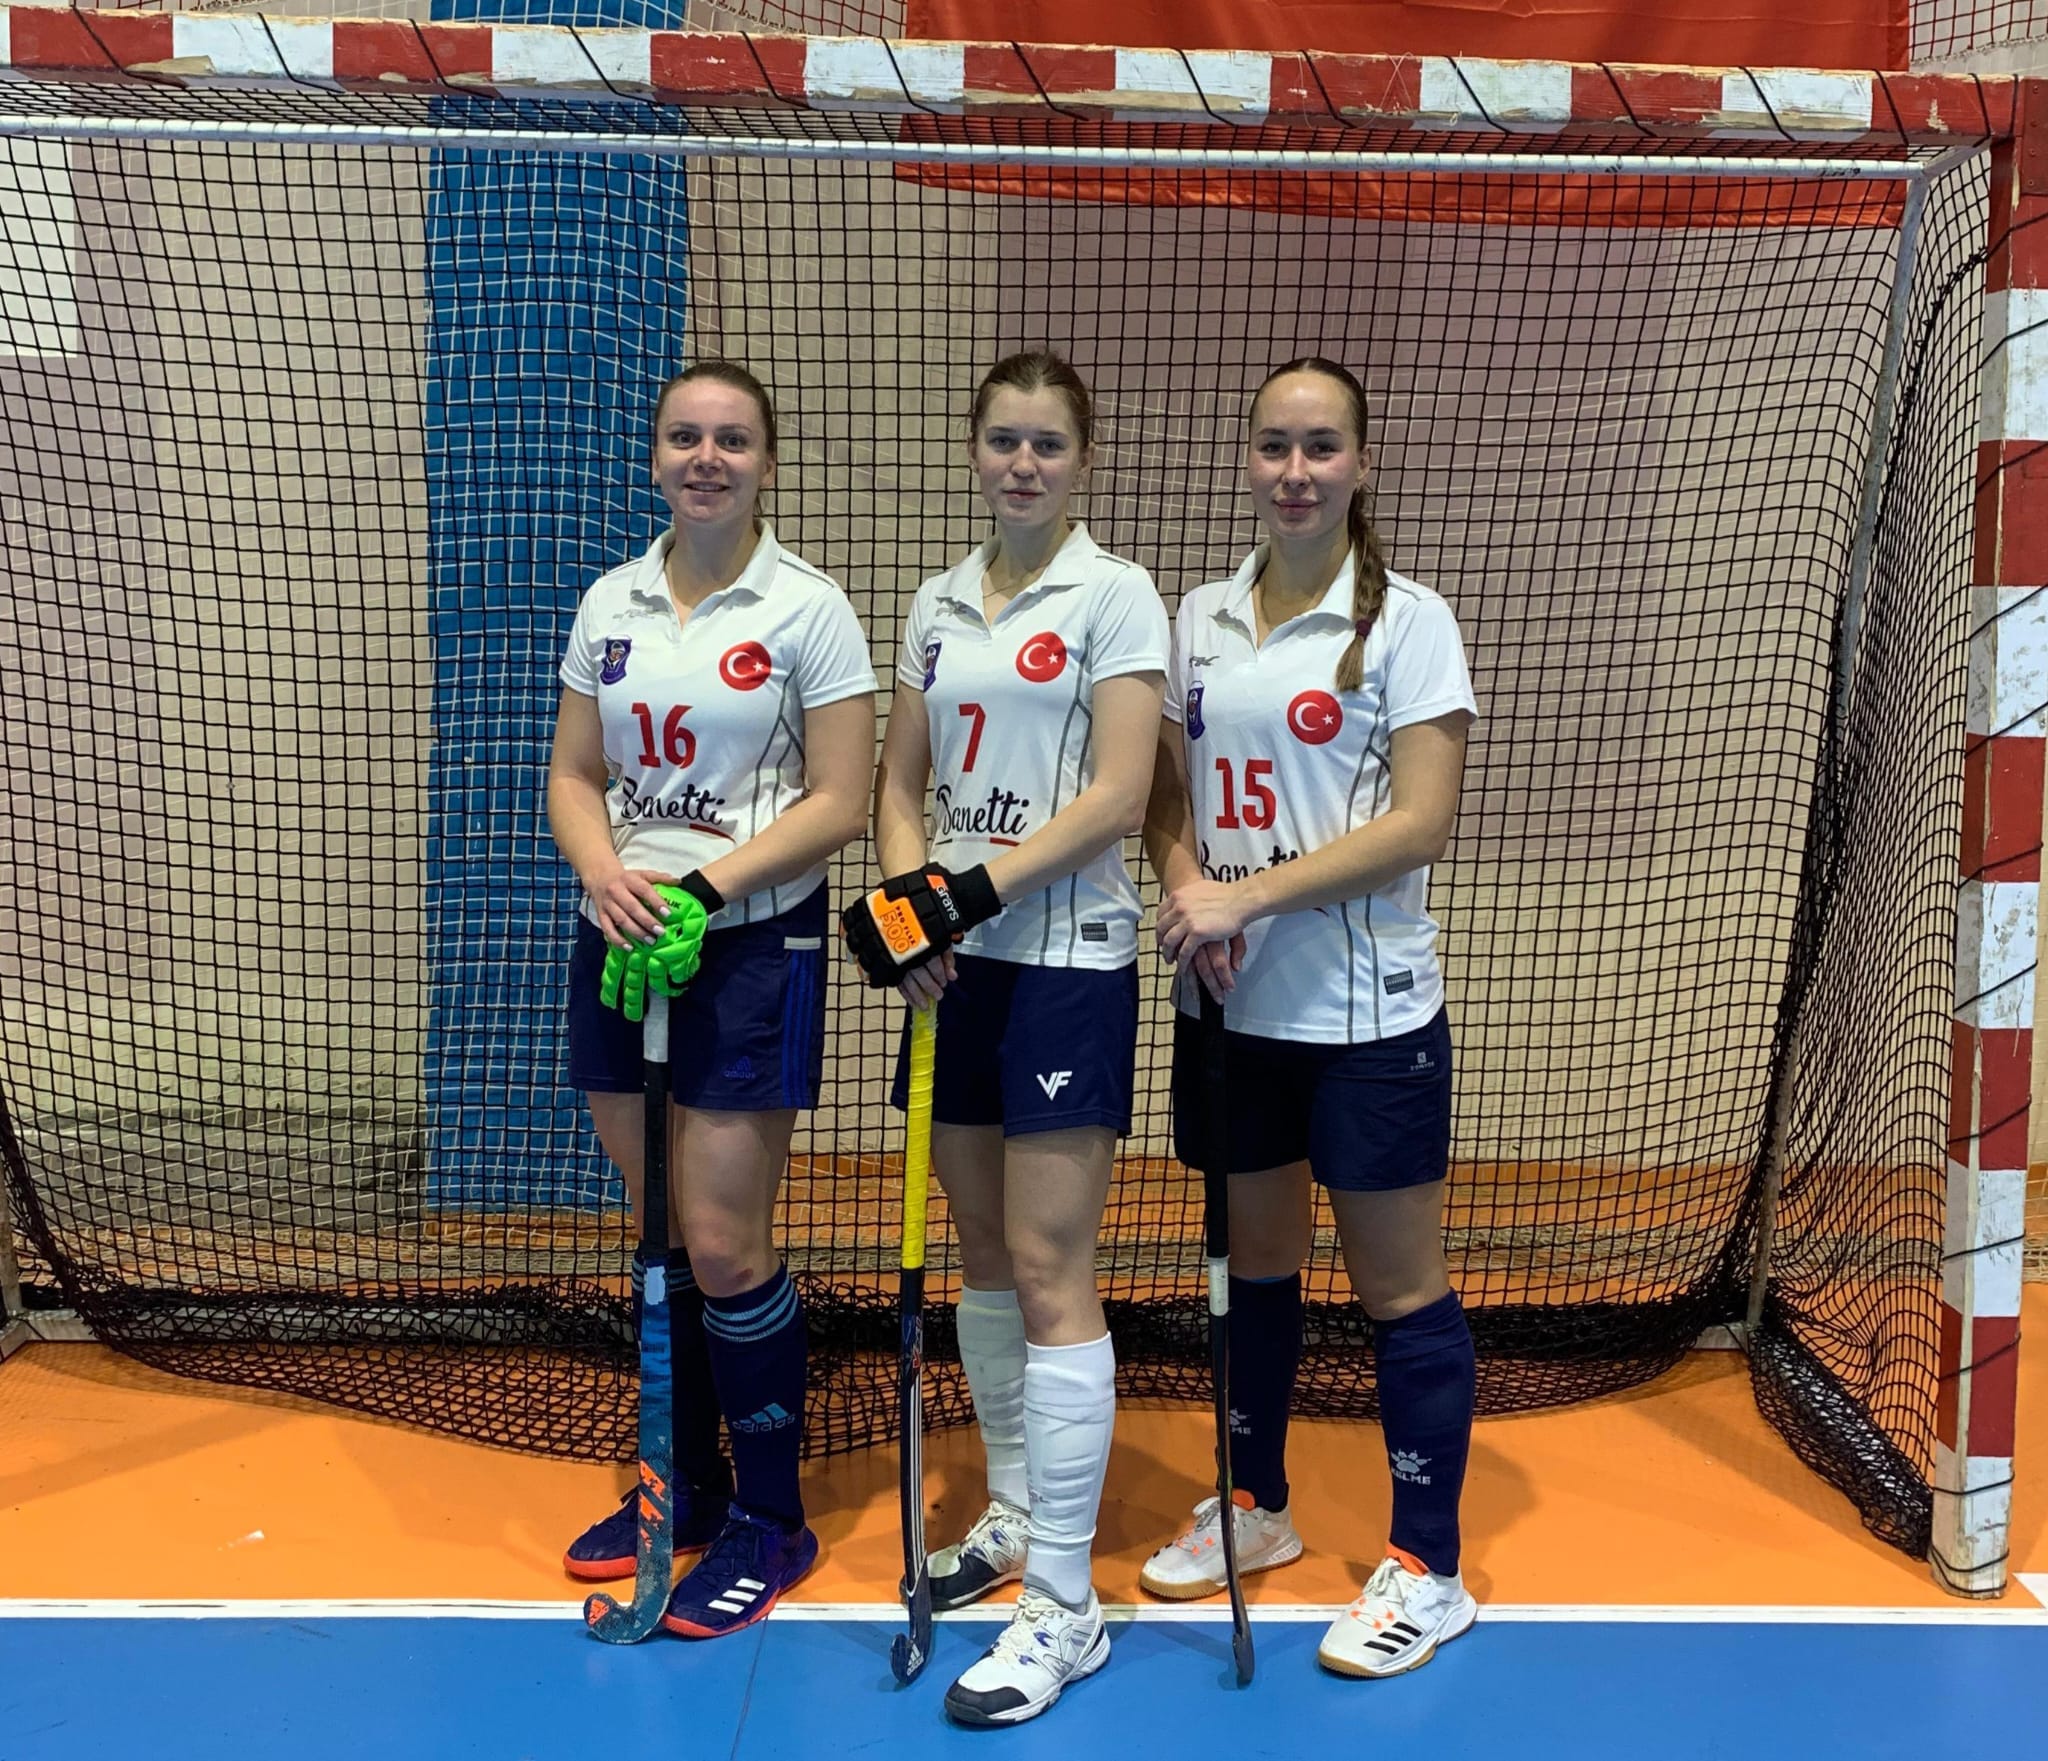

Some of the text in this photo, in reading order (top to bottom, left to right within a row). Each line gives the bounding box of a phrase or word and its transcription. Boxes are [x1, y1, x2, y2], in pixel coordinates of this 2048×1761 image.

[631, 702, 697, 769] 16
[958, 703, 986, 773] 7
[1215, 757, 1276, 831] 15
[880, 910, 910, 955] 500
